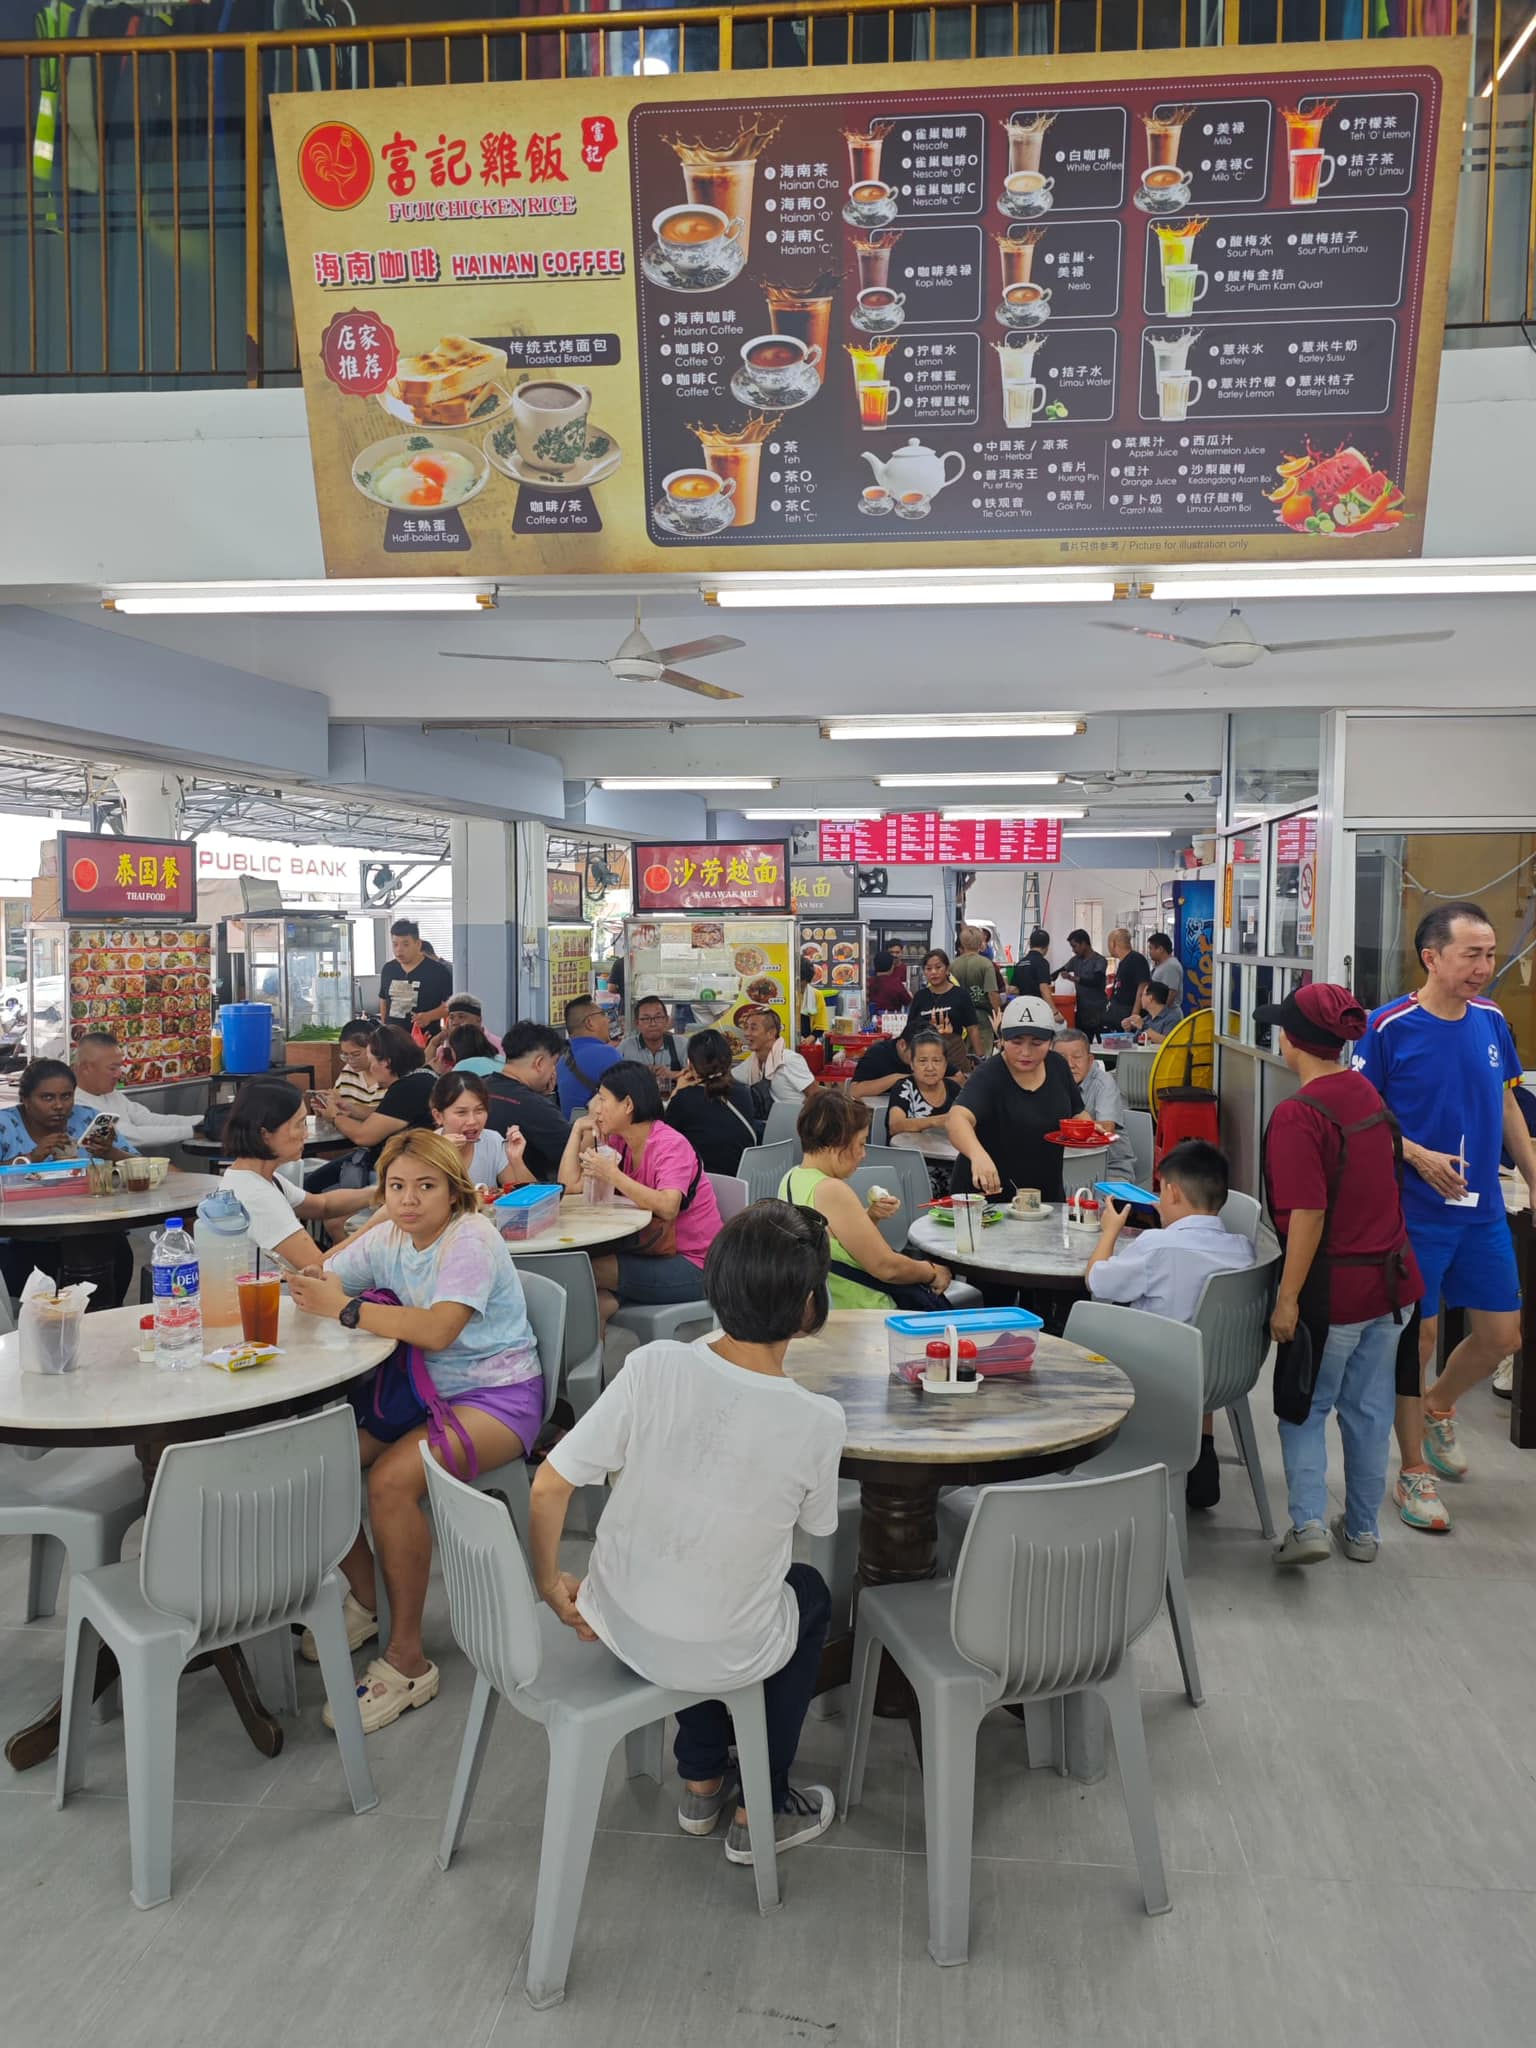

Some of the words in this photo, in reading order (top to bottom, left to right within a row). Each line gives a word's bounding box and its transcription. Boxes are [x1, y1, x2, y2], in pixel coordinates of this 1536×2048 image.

[1216, 122, 1245, 135] 美禄
[1351, 132, 1365, 140] Teh
[1383, 130, 1410, 139] Lemon
[1214, 136, 1232, 145] Milo
[913, 142, 948, 151] Nescafe
[1068, 149, 1111, 162] 白咖啡
[381, 131, 569, 196] 富記雞飯
[1066, 163, 1089, 171] White
[1093, 162, 1123, 171] Coffee
[780, 164, 828, 178] 海南茶
[913, 170, 948, 178] Nescafe
[1348, 168, 1362, 176] Teh
[1380, 167, 1404, 175] Limau
[1212, 172, 1229, 181] Milo
[780, 180, 814, 190] Hainan
[817, 179, 839, 189] Cha
[780, 197, 825, 210] 海南O
[913, 197, 948, 206] Nescafe
[389, 202, 432, 222] FUJI
[435, 199, 525, 220] CHICKEN
[528, 196, 575, 217] RICE
[780, 213, 814, 222] Hainan
[781, 229, 824, 243] 海南C
[1230, 235, 1272, 247] 酸梅水
[781, 245, 815, 255] Hainan
[1227, 249, 1247, 258] Sour
[1251, 248, 1273, 257] Plum
[1297, 246, 1317, 255] Sour
[1319, 246, 1339, 255] Plum
[1342, 245, 1368, 254] Limau
[315, 249, 440, 285] 海南咖啡
[452, 253, 536, 277] HAINAN
[542, 250, 623, 274] COFFEE
[916, 279, 933, 288] Kopi
[936, 278, 953, 287] Milo
[1068, 282, 1091, 291] Neslo
[1225, 283, 1246, 292] Sour
[1248, 282, 1270, 291] Plum
[1274, 282, 1295, 290] Kam
[1298, 280, 1323, 289] Quat
[674, 310, 736, 324] 海南咖啡
[674, 326, 707, 336] Hainan
[710, 325, 743, 335] Coffee
[510, 339, 607, 353] 传统式烤面包
[676, 342, 718, 356] 咖啡O
[525, 354, 562, 363] Toasted
[564, 353, 592, 362] Bread
[675, 357, 708, 366] Coffee
[1220, 357, 1246, 366] Barley
[1299, 354, 1324, 363] Barley
[1327, 354, 1345, 362] Susu
[676, 374, 717, 386] 咖啡C
[676, 387, 709, 397] Coffee
[1218, 390, 1244, 399] Barley
[1246, 389, 1274, 398] Lemon
[1297, 388, 1322, 397] Barley
[1324, 388, 1349, 396] Limau
[1193, 435, 1233, 446] 西瓜汁
[784, 442, 798, 453] 茶
[1191, 447, 1241, 455] Watermelon
[1243, 446, 1265, 454] Juice
[984, 453, 998, 461] Tea
[1129, 449, 1154, 457] Apple
[784, 455, 800, 464] Teh
[1058, 474, 1085, 482] Hueng
[1121, 478, 1152, 486] Orange
[1188, 476, 1236, 484] Kedongdong
[784, 484, 800, 493] Teh
[1006, 482, 1022, 490] King
[1076, 502, 1092, 510] Pou
[785, 514, 800, 522] Teh
[983, 510, 993, 518] Tie
[526, 515, 558, 524] Coffee
[571, 515, 587, 523] Tea
[402, 520, 446, 531] 生熟蛋
[392, 533, 440, 542] Half-boiled
[442, 533, 459, 542] Egg
[1130, 541, 1161, 550] Picture
[1165, 540, 1176, 549] for
[1180, 540, 1226, 549] illustration
[1229, 539, 1248, 551] only
[199, 852, 282, 872] PUBLIC
[291, 858, 348, 877] BANK
[114, 854, 181, 889] 泰国餐
[673, 854, 778, 887] 沙劳越面
[126, 892, 146, 901] THAI
[147, 892, 166, 901] FOOD
[1019, 1008, 1034, 1022] A
